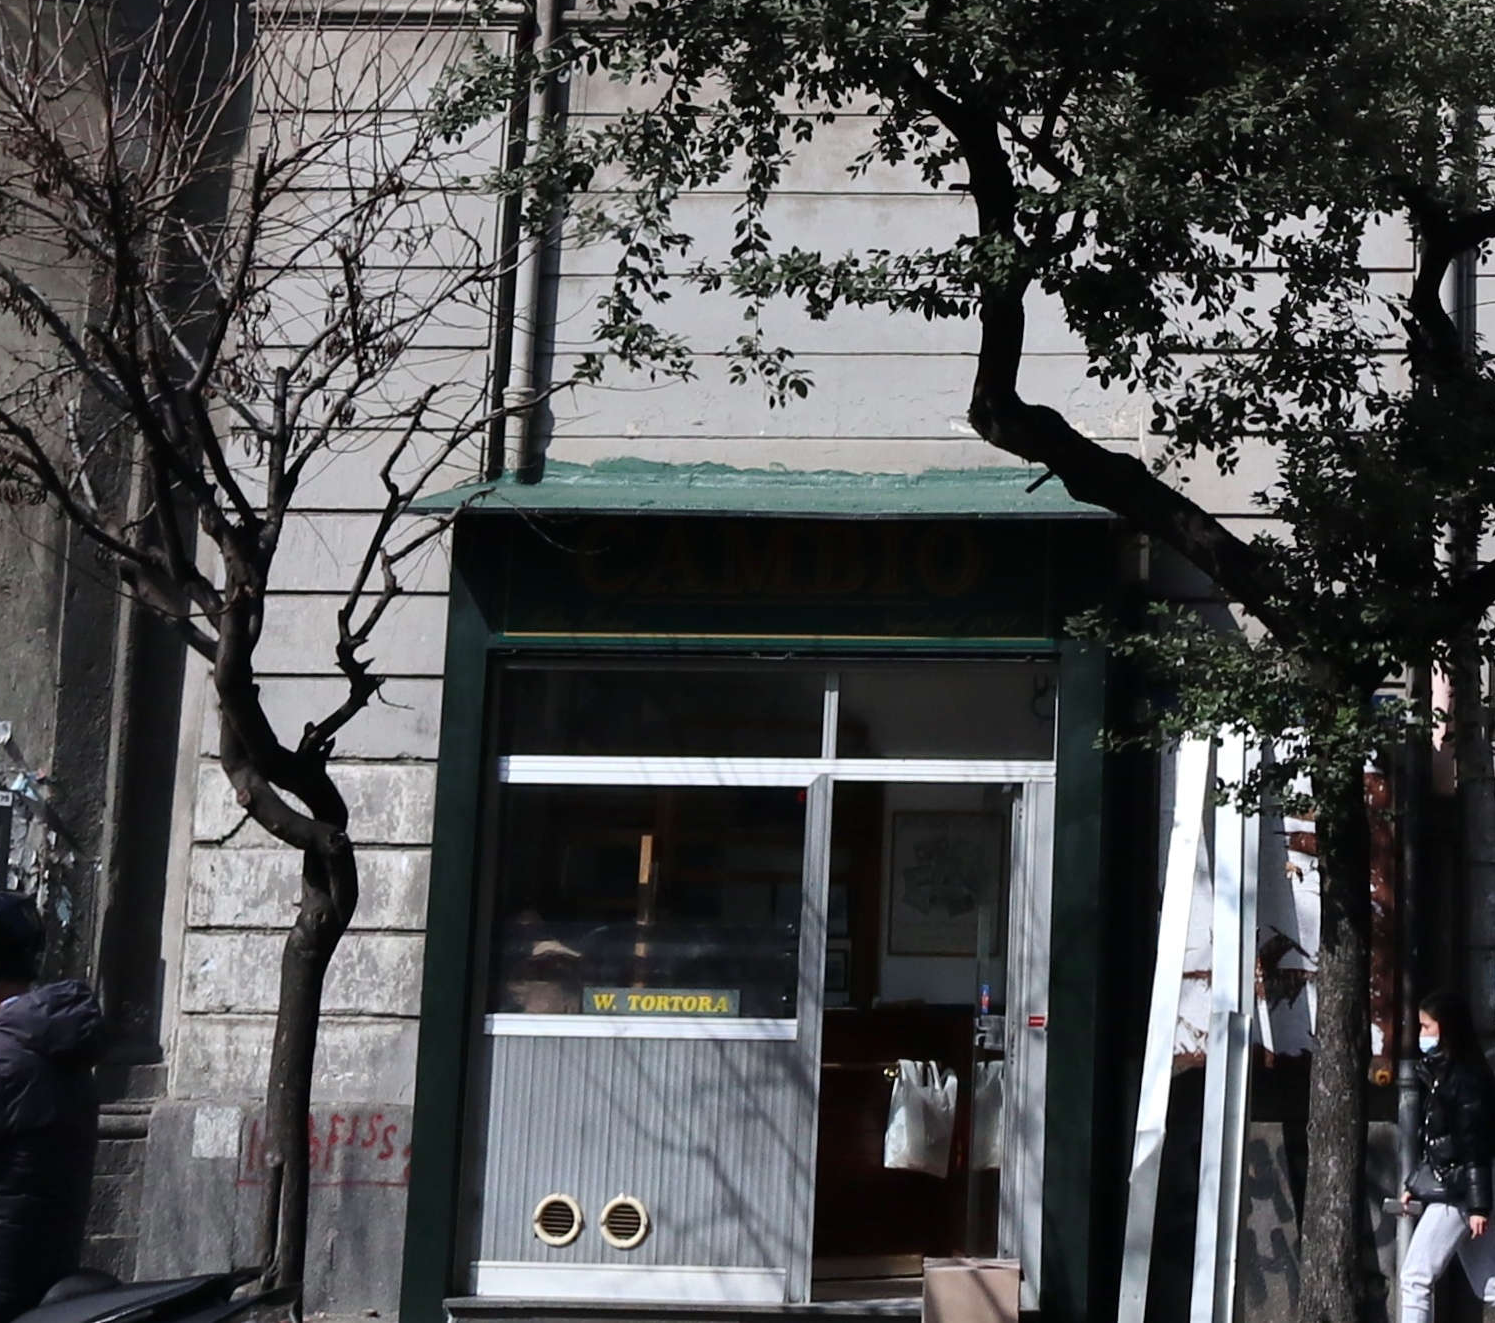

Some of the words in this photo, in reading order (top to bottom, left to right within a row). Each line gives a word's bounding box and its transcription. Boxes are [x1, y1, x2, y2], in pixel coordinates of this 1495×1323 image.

[573, 519, 984, 598] CAMBIO
[593, 993, 617, 1012] W.
[627, 994, 729, 1013] TORTORA
